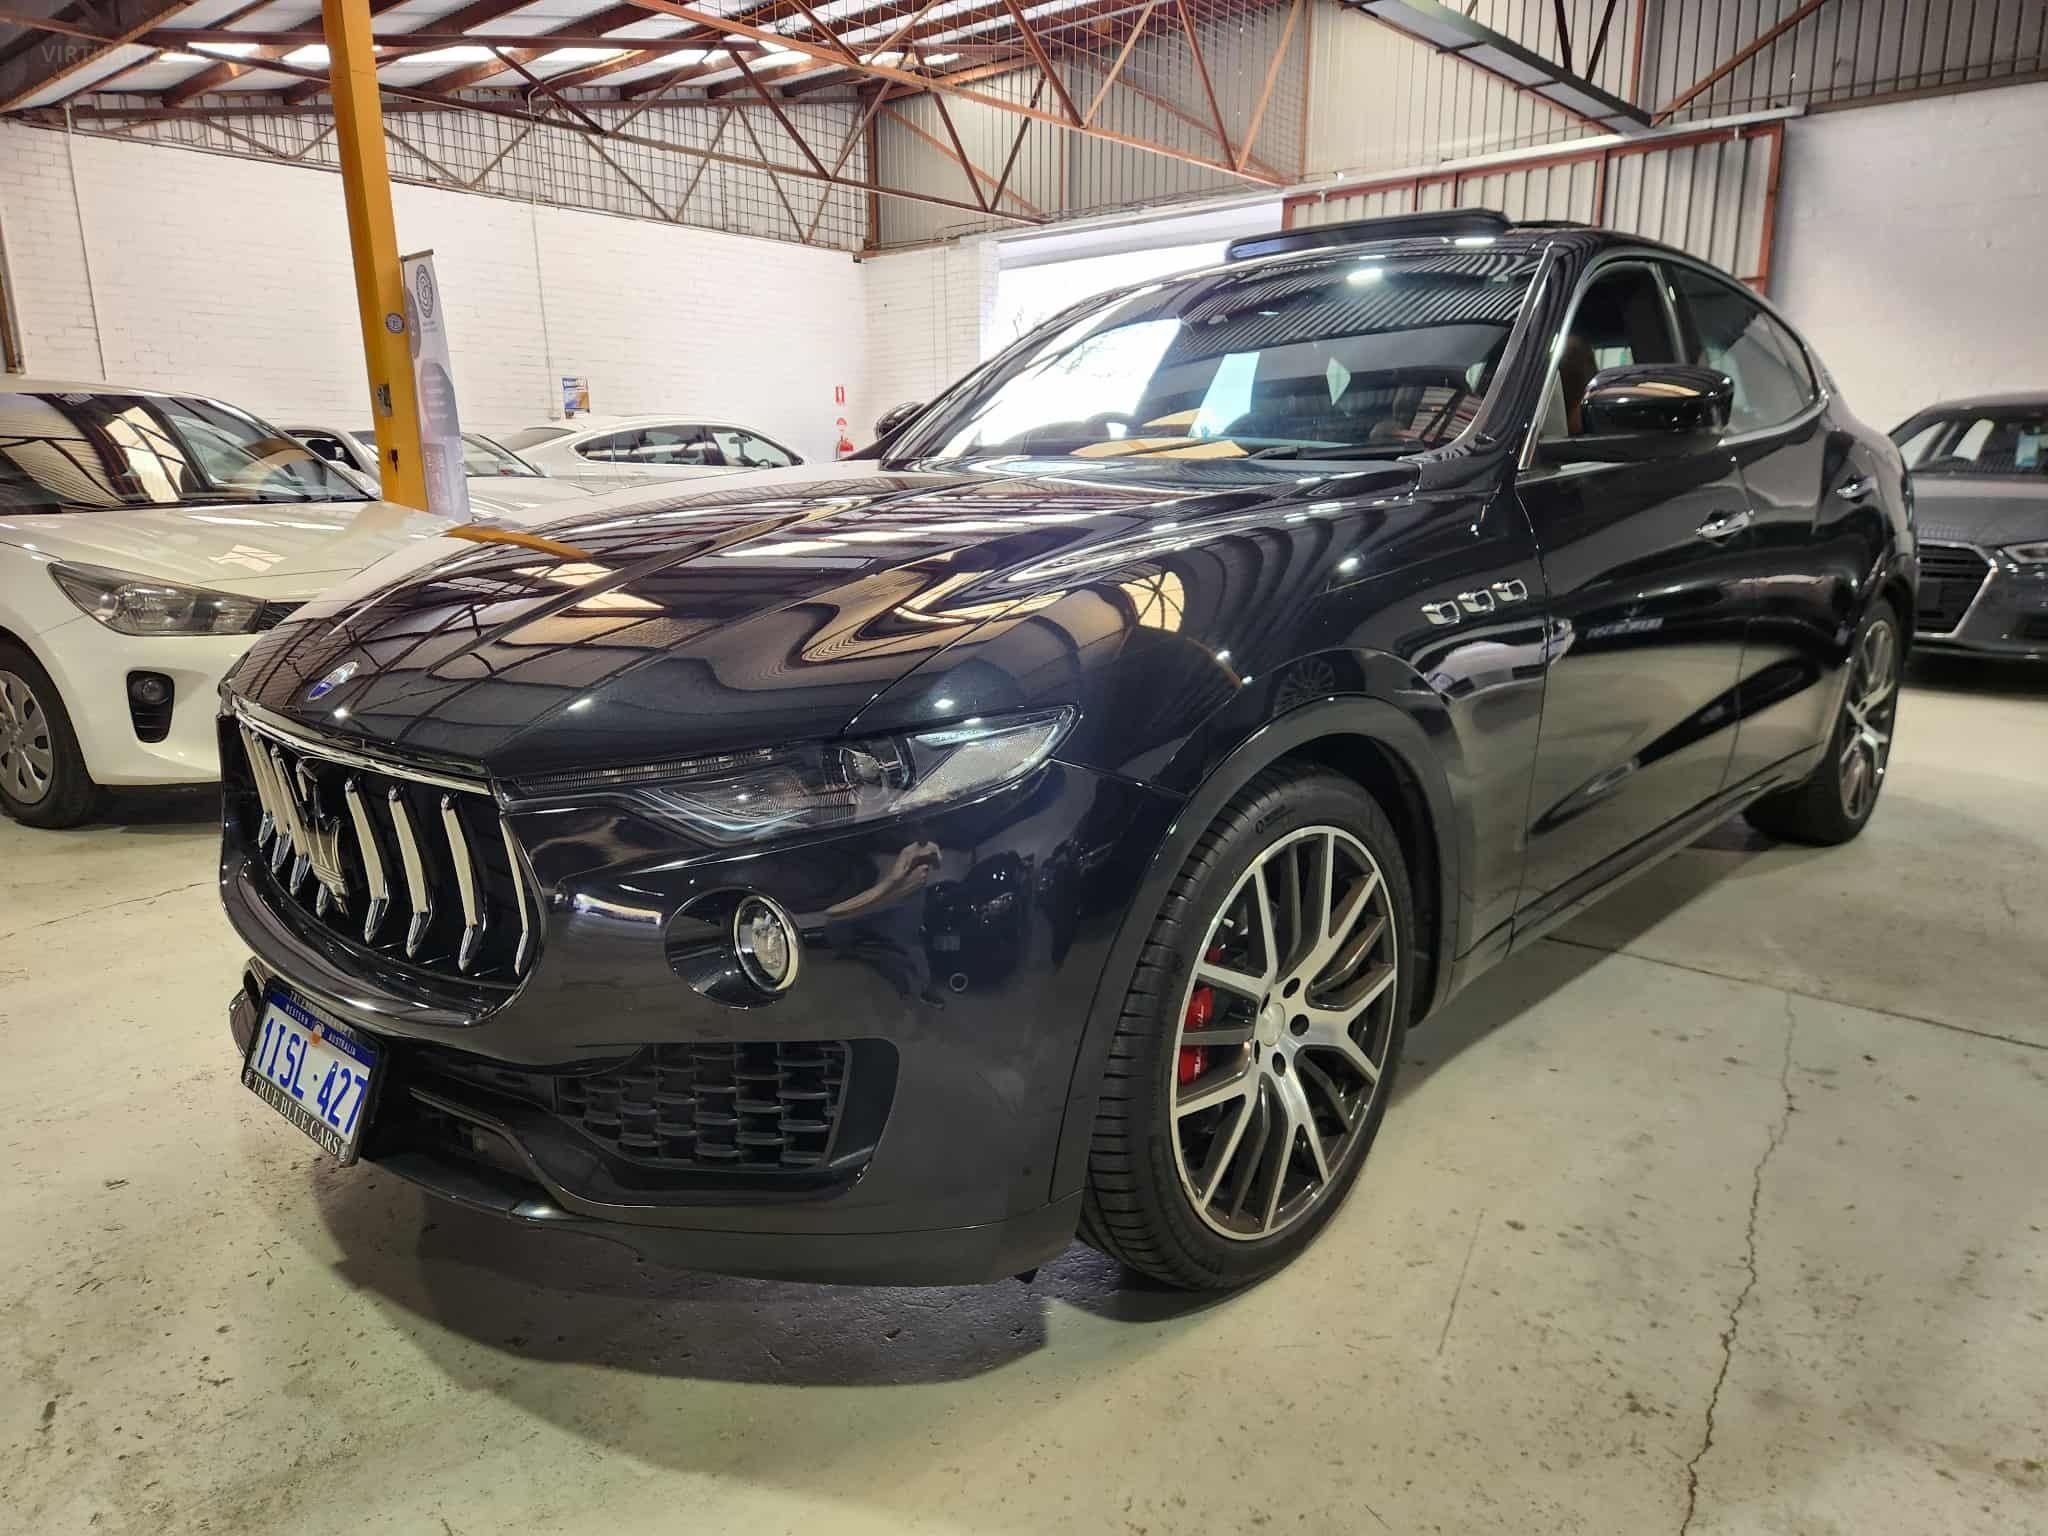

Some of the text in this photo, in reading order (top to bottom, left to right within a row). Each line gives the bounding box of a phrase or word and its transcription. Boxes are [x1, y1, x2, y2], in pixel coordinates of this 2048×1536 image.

[252, 1074, 341, 1156] TRUE BLUE CARS
